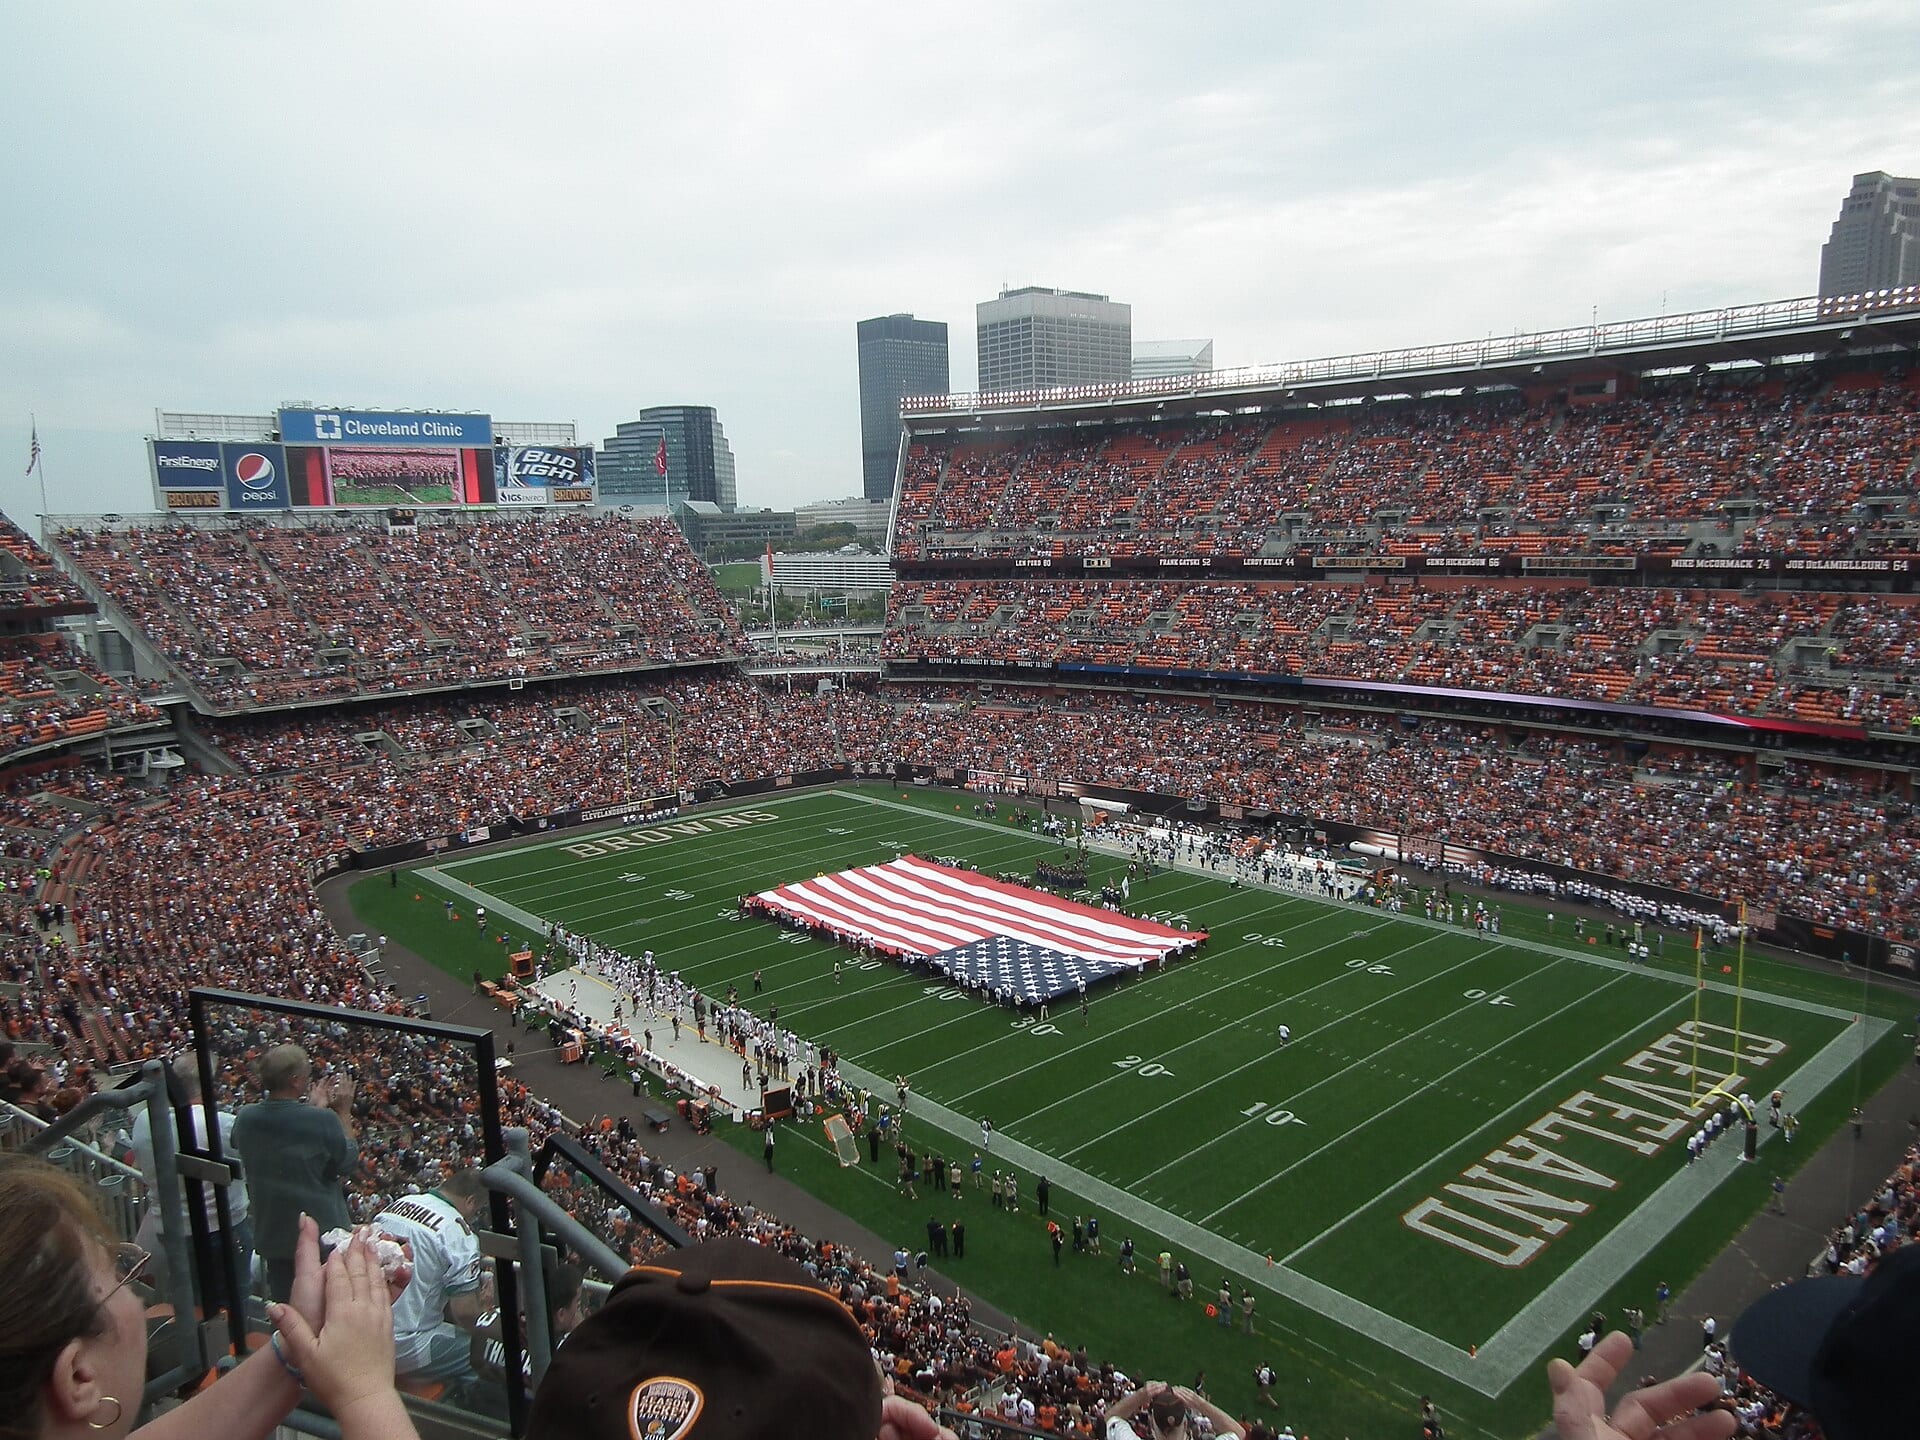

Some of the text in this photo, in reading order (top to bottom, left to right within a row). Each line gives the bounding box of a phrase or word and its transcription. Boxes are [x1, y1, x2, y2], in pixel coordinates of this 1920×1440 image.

[345, 420, 463, 437] Cleveland Clinic
[158, 455, 219, 469] FirstEnergy
[522, 450, 577, 469] BUD
[512, 463, 579, 480] LIGHT
[168, 492, 219, 507] BROWNS
[242, 490, 277, 503] pepsi
[554, 489, 592, 500] BROWNS
[1159, 558, 1178, 566] FRANK
[1202, 559, 1211, 567] 52
[1243, 558, 1295, 566] LEROY KELLY 44
[1426, 558, 1445, 566] GENE
[1488, 558, 1500, 567] 66
[1671, 559, 1694, 568] MIKE
[1757, 559, 1770, 569] 74
[1785, 560, 1804, 569] JOE
[1893, 560, 1909, 571] 64
[560, 810, 779, 858] BROWNS
[1112, 1055, 1165, 1076] 20
[1240, 1102, 1295, 1126] 10
[1401, 1020, 1789, 1267] CLEVELAND
[640, 1395, 690, 1409] SEASON
[639, 1402, 689, 1419] TICKET
